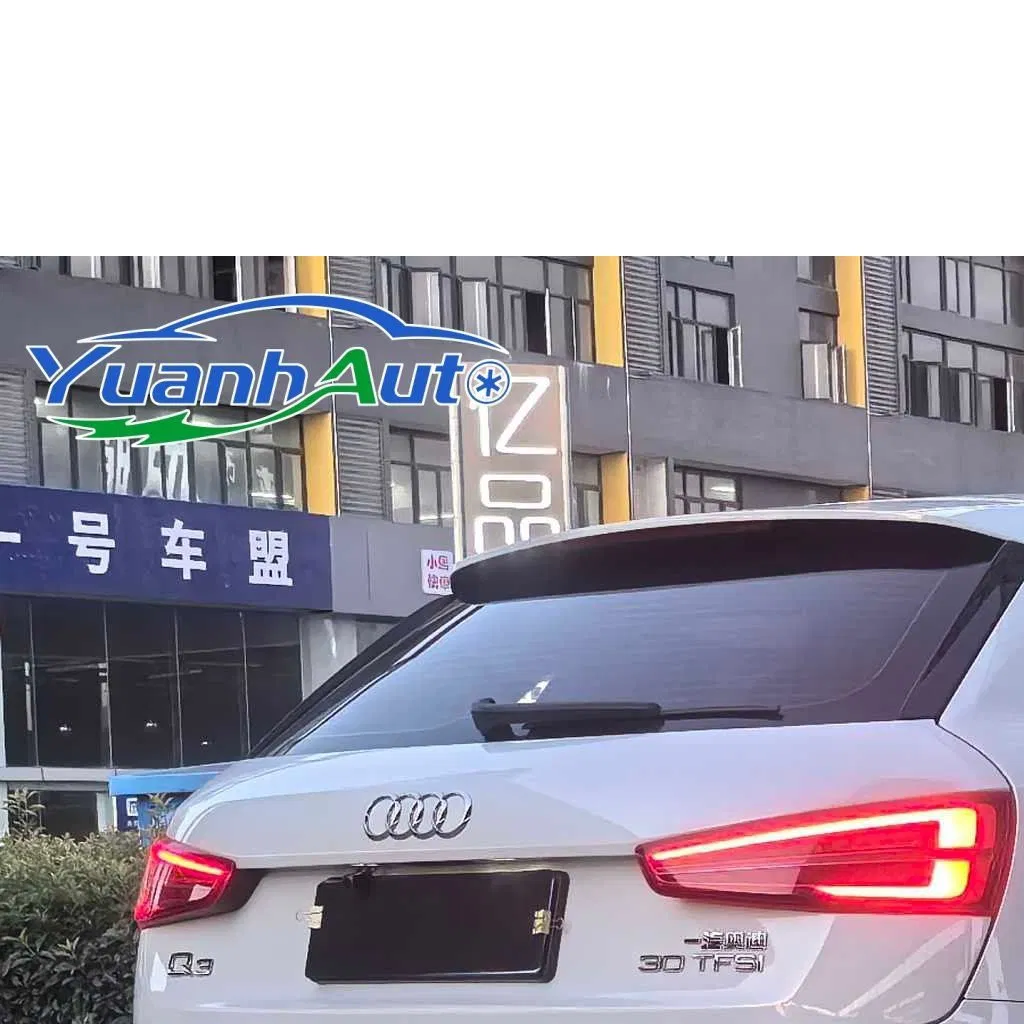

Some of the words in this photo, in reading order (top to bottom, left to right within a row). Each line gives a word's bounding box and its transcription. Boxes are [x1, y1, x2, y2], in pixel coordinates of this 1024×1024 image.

[168, 952, 215, 977] Q3
[638, 954, 686, 973] 30
[692, 954, 765, 973] TFSI
